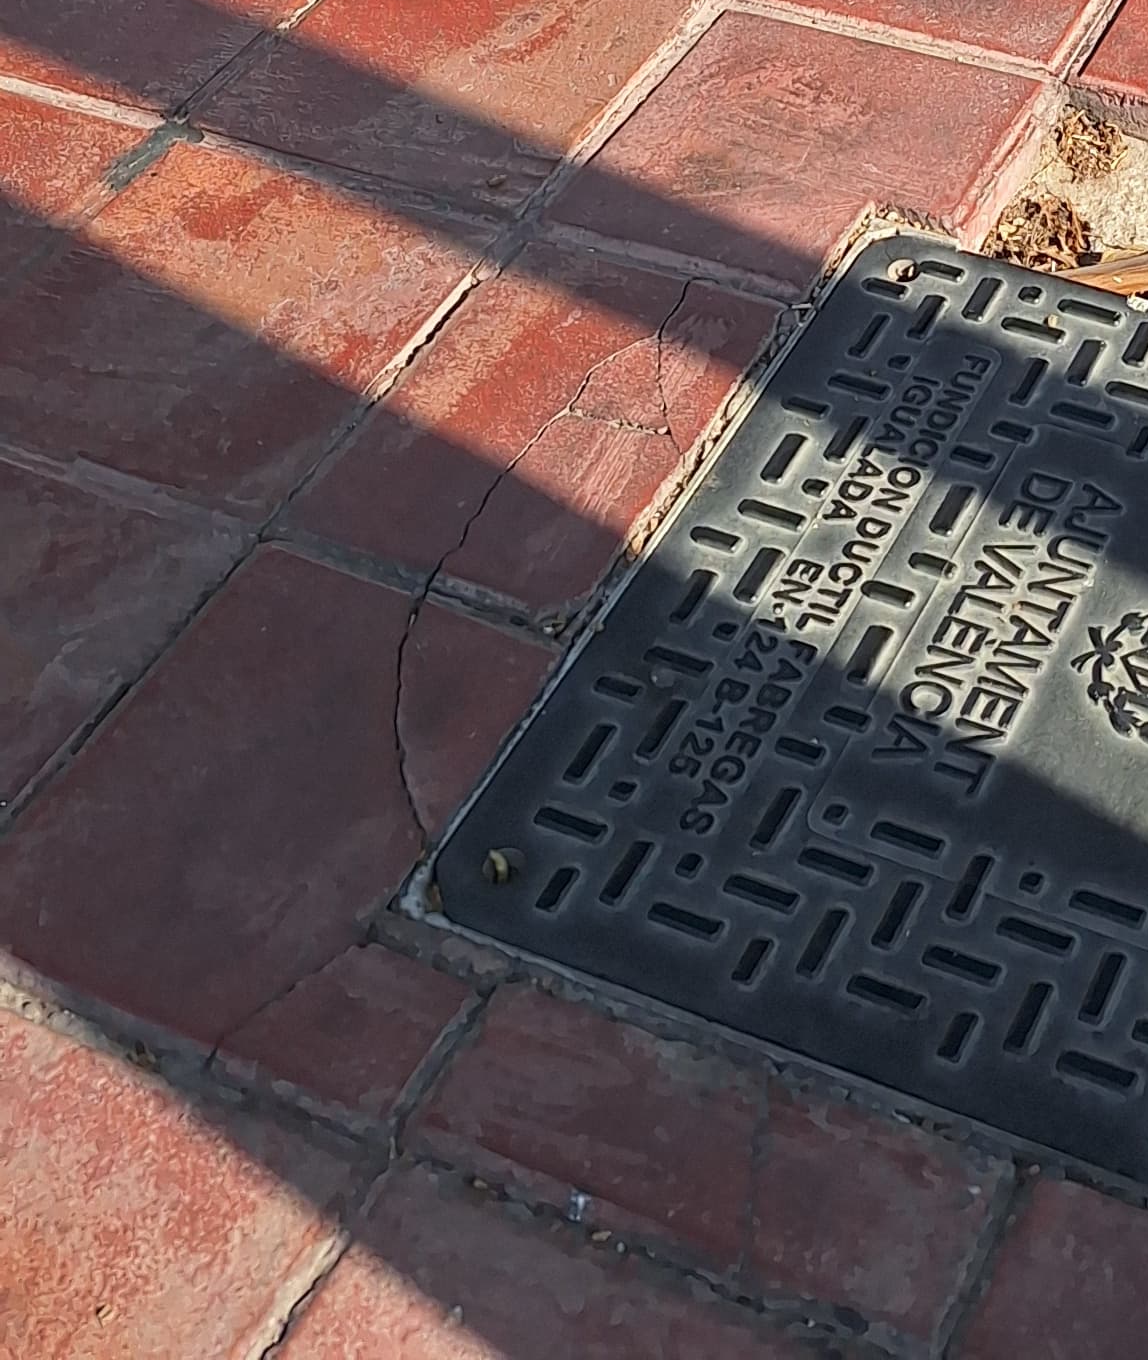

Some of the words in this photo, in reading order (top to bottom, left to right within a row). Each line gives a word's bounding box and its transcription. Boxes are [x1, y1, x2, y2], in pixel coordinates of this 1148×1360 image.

[819, 372, 942, 521] IGUALADA
[869, 353, 993, 515] FUNDICION
[995, 468, 1074, 540] DE
[792, 513, 894, 631] DUCTIL
[865, 542, 1041, 755] VALÈNCIA
[928, 480, 1125, 799] AJUNTAMENT
[665, 674, 752, 781] B-125
[674, 637, 819, 837] FABREGAS
